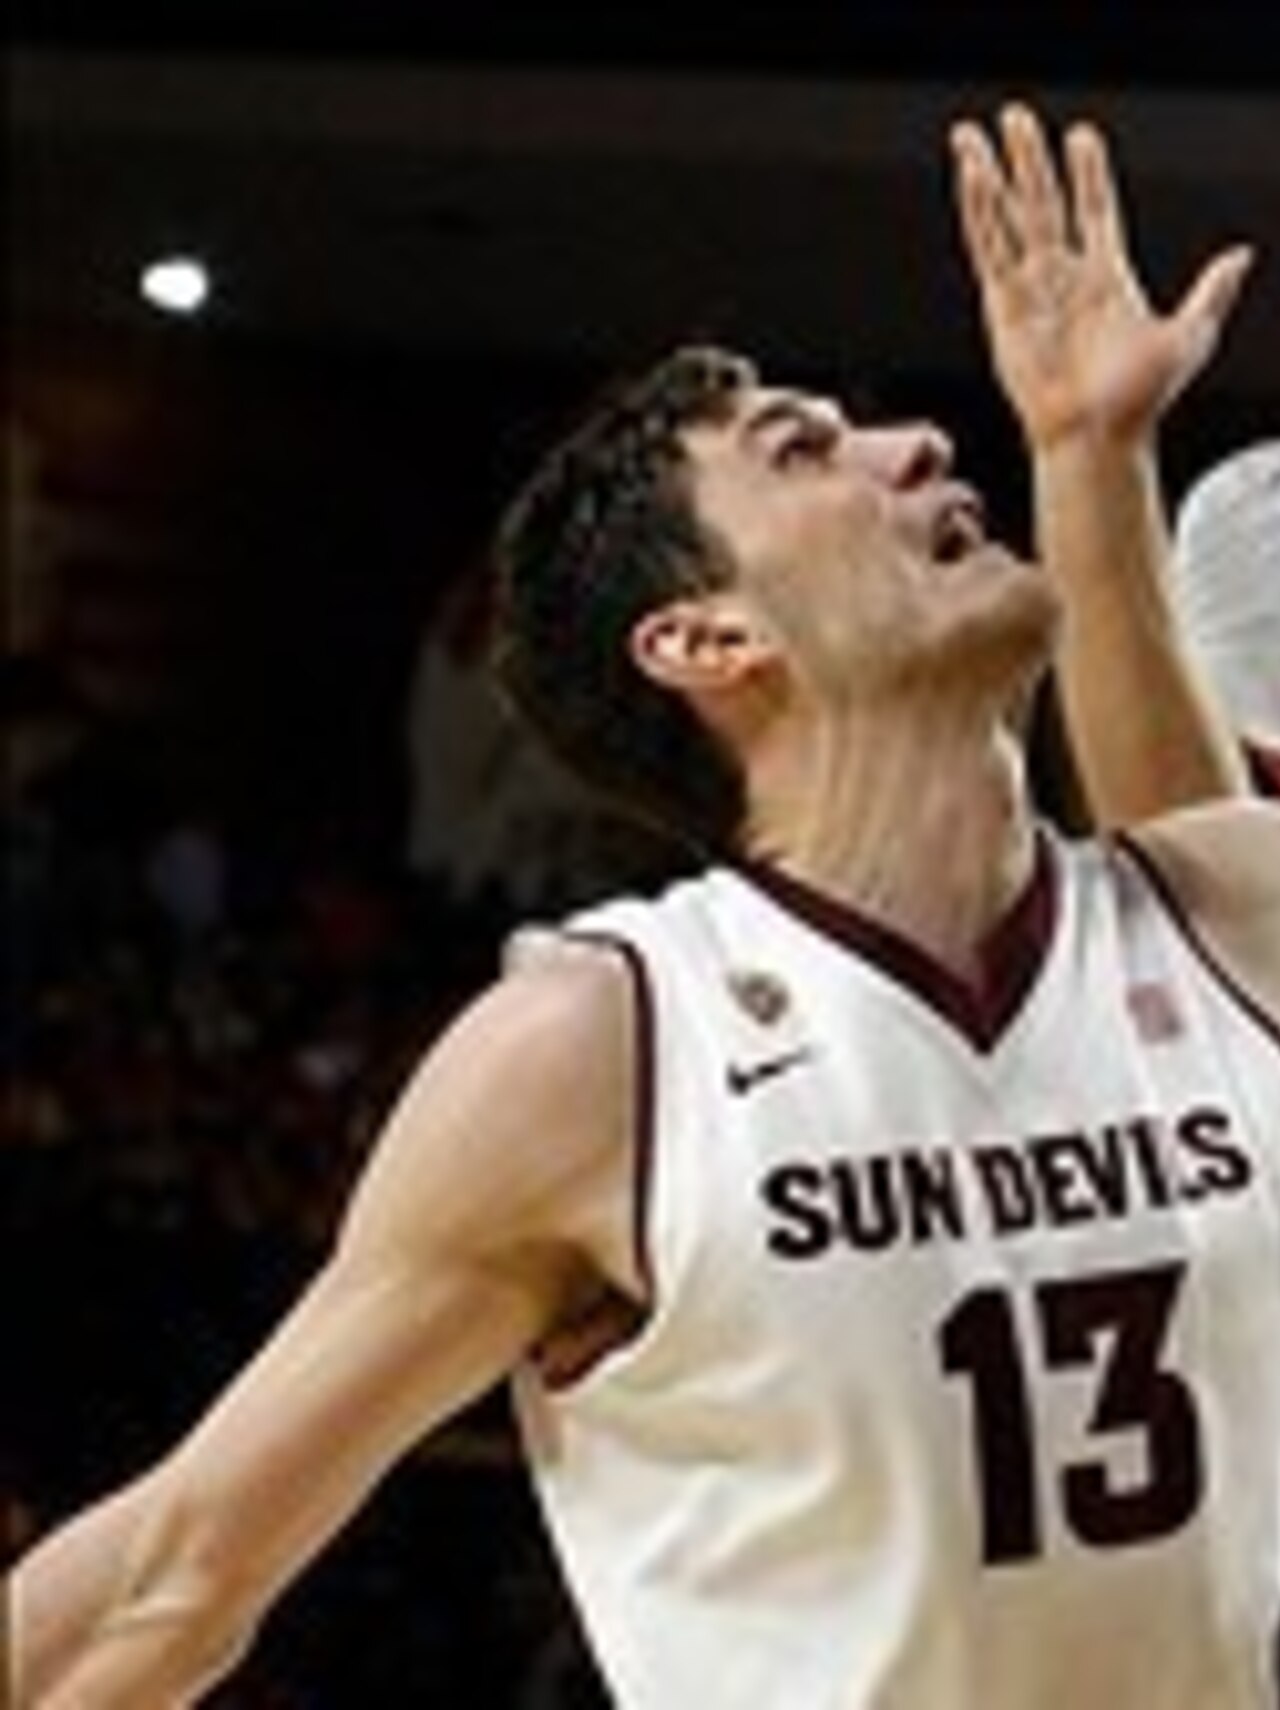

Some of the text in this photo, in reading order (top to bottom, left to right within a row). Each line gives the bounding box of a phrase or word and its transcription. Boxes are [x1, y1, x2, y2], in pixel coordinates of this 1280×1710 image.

[761, 1107, 1252, 1261] SUN DEVIS
[936, 1260, 1206, 1568] 13
